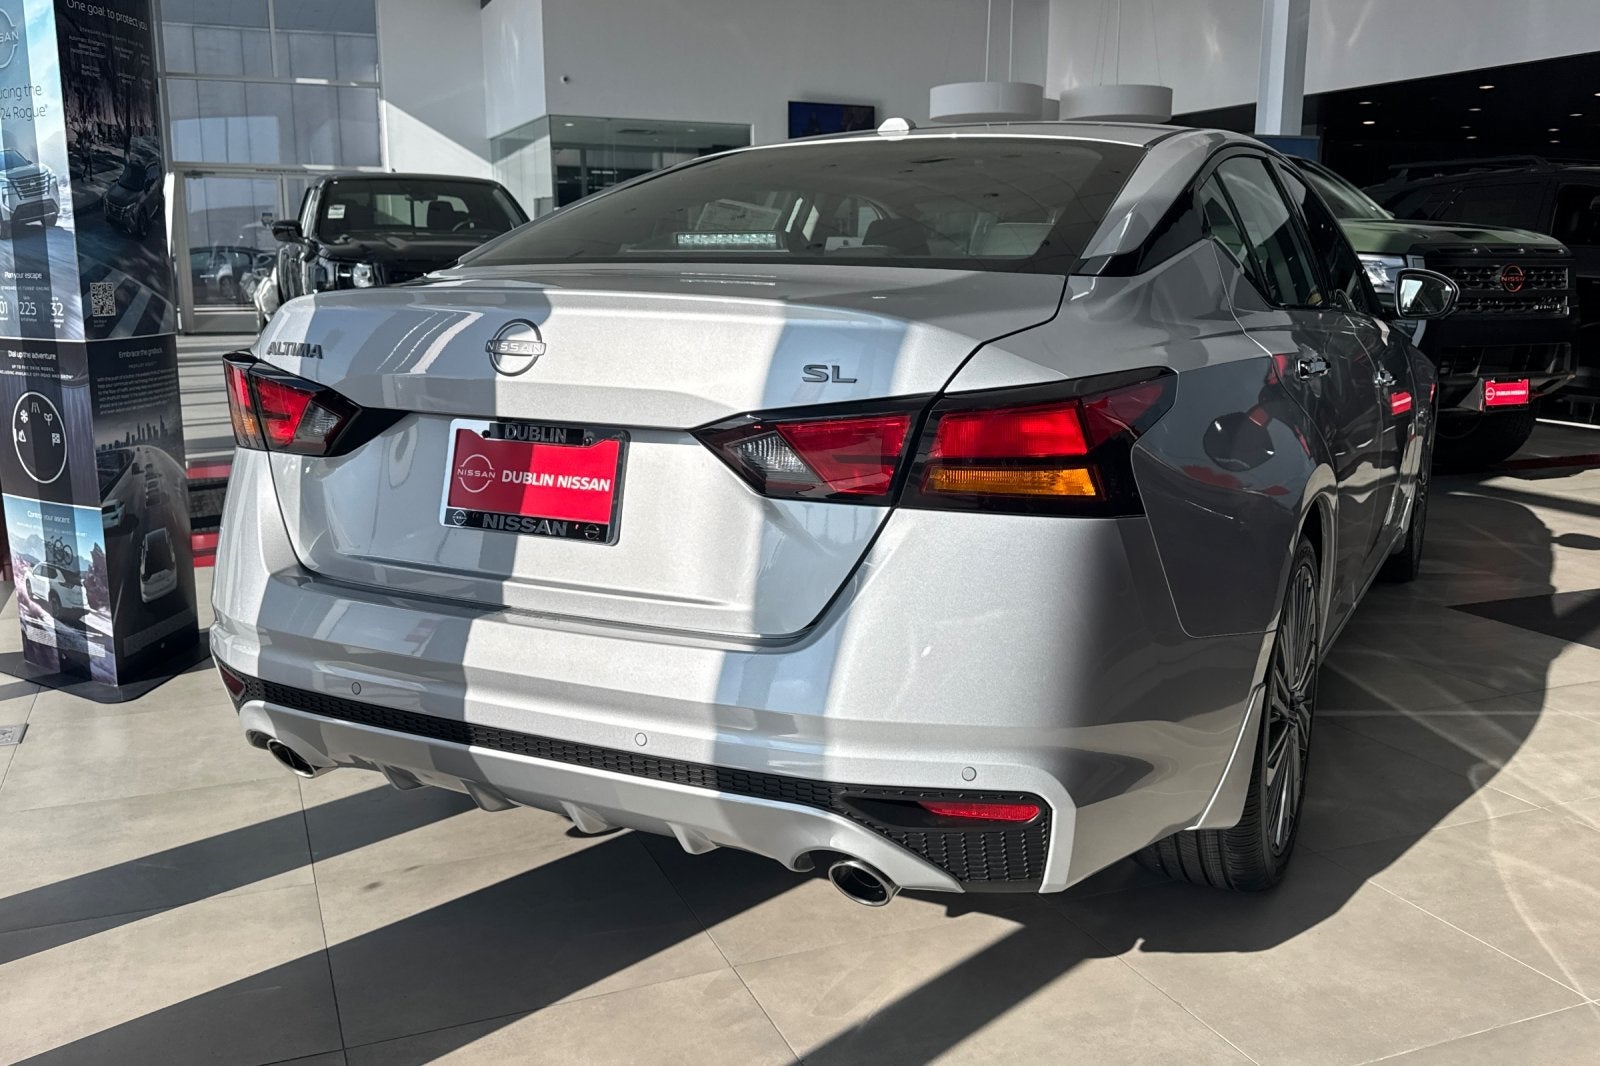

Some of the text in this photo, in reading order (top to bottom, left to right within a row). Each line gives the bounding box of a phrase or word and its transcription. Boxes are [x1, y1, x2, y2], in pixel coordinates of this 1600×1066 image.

[66, 0, 147, 31] One goal to protect you
[24, 83, 42, 96] the
[24, 272, 42, 280] escape
[19, 301, 37, 316] 225
[50, 302, 64, 316] 32
[119, 350, 139, 358] Embrace
[266, 341, 323, 360] ALTIMA
[487, 341, 545, 355] NISSAN
[32, 352, 56, 360] adventure
[802, 364, 858, 384] SL
[504, 424, 567, 444] DUBLIN
[456, 467, 496, 479] NISSAN
[502, 469, 611, 492] DUBLIN NISSAN
[482, 513, 568, 536] NISSAN
